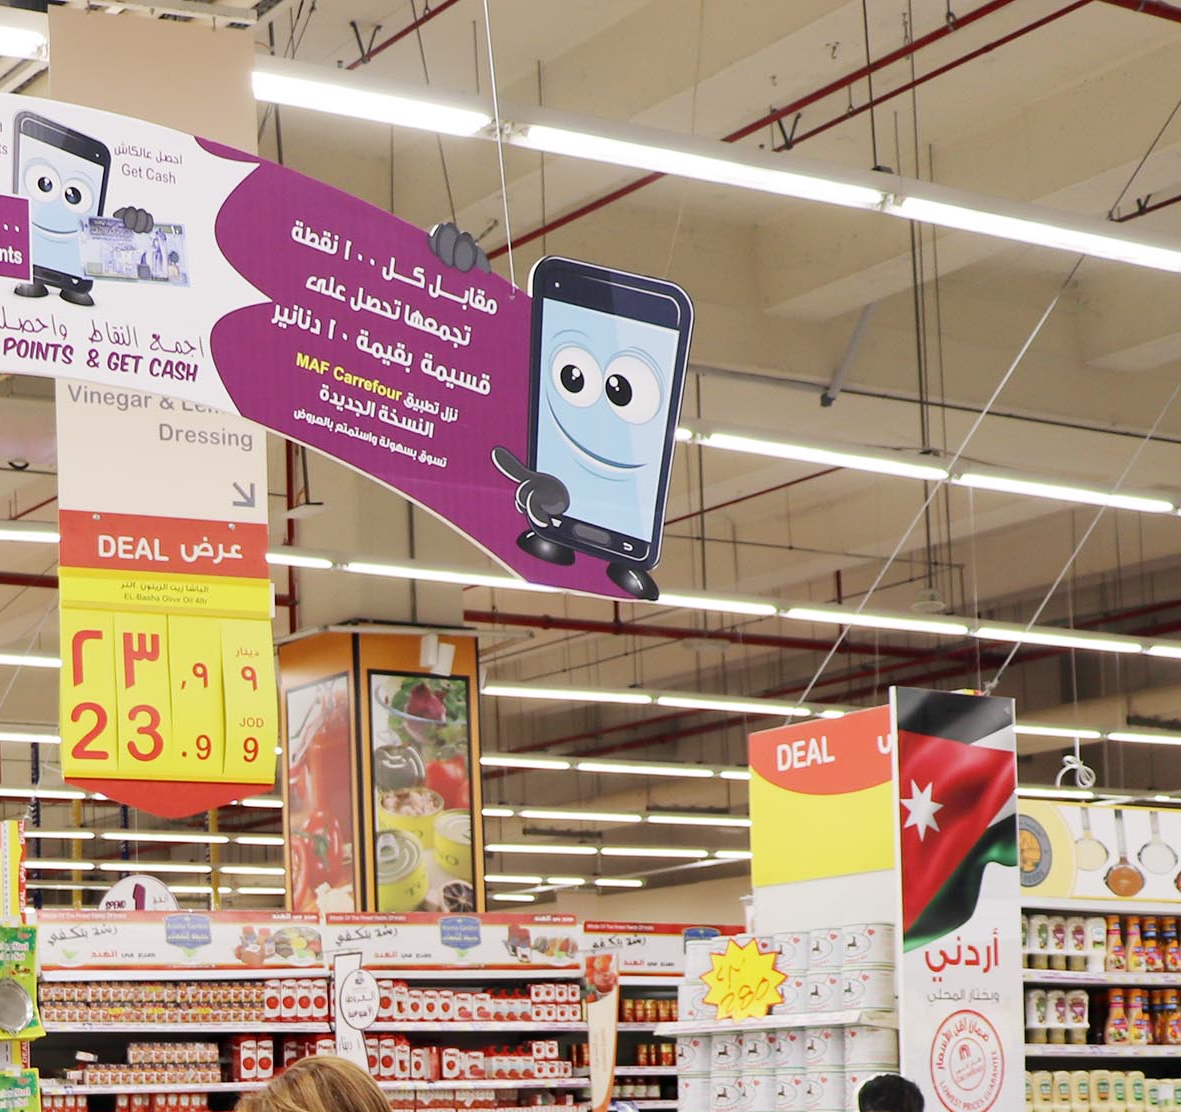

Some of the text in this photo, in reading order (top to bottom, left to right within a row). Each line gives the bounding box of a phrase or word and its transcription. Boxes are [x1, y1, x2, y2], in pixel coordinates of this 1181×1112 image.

[113, 141, 183, 166] احصل عالكاش
[121, 163, 177, 185] Get Cash
[291, 219, 499, 316] مقابل كل ١٠٠ نقطة
[305, 273, 473, 347] تجمعها تحصل على
[89, 318, 138, 349] النقاط
[149, 334, 205, 359] اجمع
[271, 302, 492, 396] قسيمة بقيمة دنانير
[3, 338, 75, 366] POINTS
[86, 350, 100, 369] &
[107, 352, 144, 374] GET
[149, 357, 199, 382] CASH
[68, 383, 152, 411] Vinegar
[295, 351, 459, 423] نزل تطبيق MAF Carrefour
[319, 384, 435, 439] النسخة الجديدة
[159, 423, 253, 451] Dressing
[380, 435, 418, 466] بسهولة
[418, 449, 448, 469] تسوق
[98, 535, 243, 564] DEAL عرض
[239, 717, 264, 728] JOD
[776, 735, 836, 772] DEAL
[923, 927, 1001, 983] أردني
